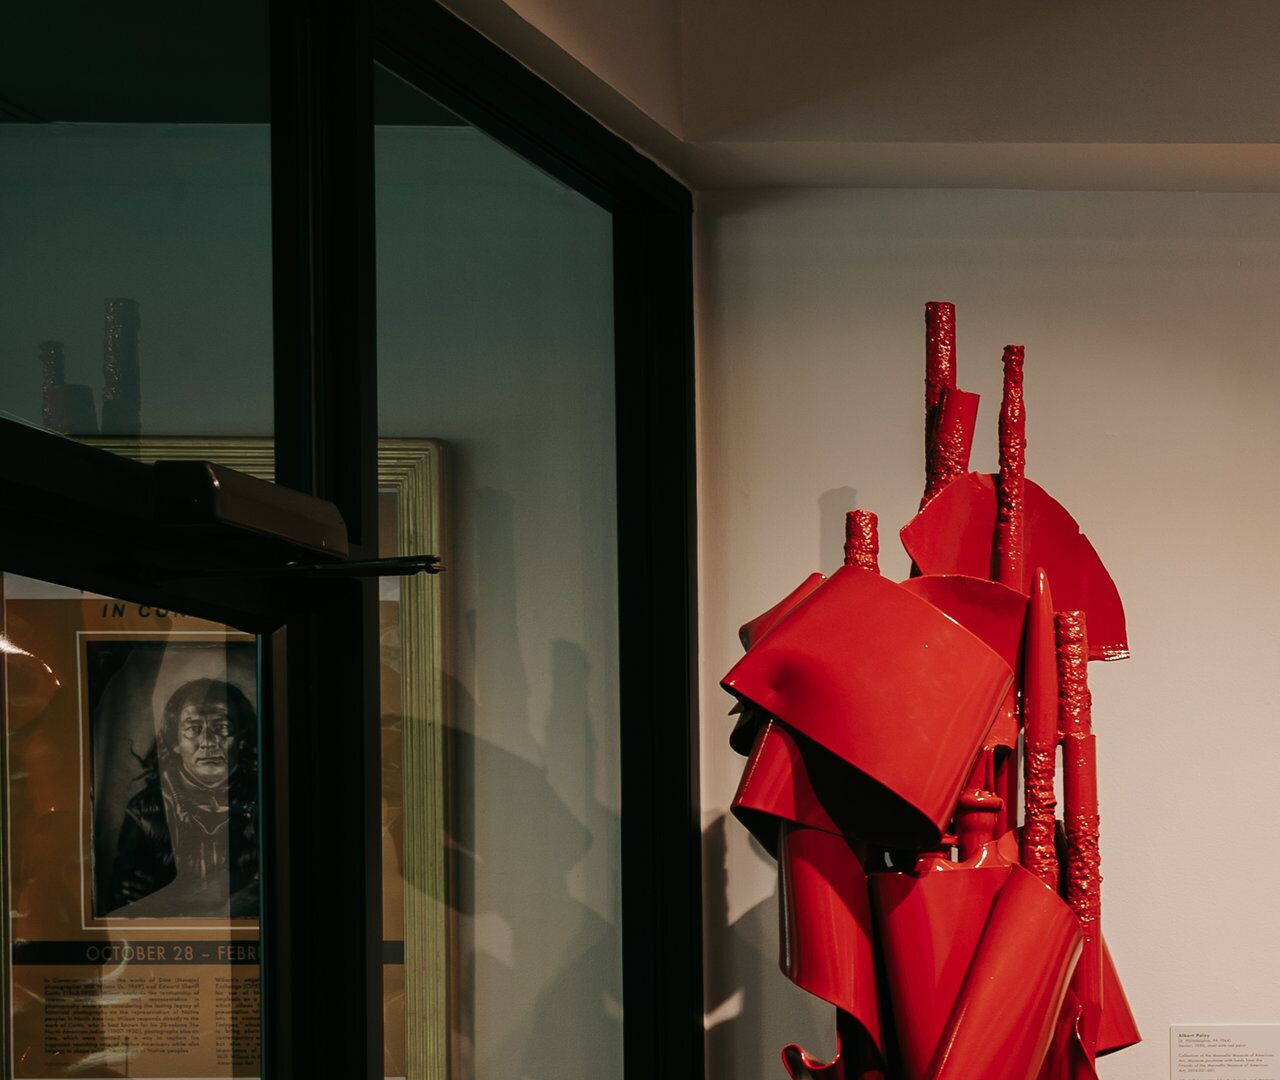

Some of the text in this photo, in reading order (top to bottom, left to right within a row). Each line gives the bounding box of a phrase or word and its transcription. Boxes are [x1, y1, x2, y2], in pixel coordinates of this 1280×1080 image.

[102, 603, 126, 618] IN
[86, 945, 171, 961] OCTOBER
[173, 945, 194, 961] 28
[217, 945, 261, 961] FEBR
